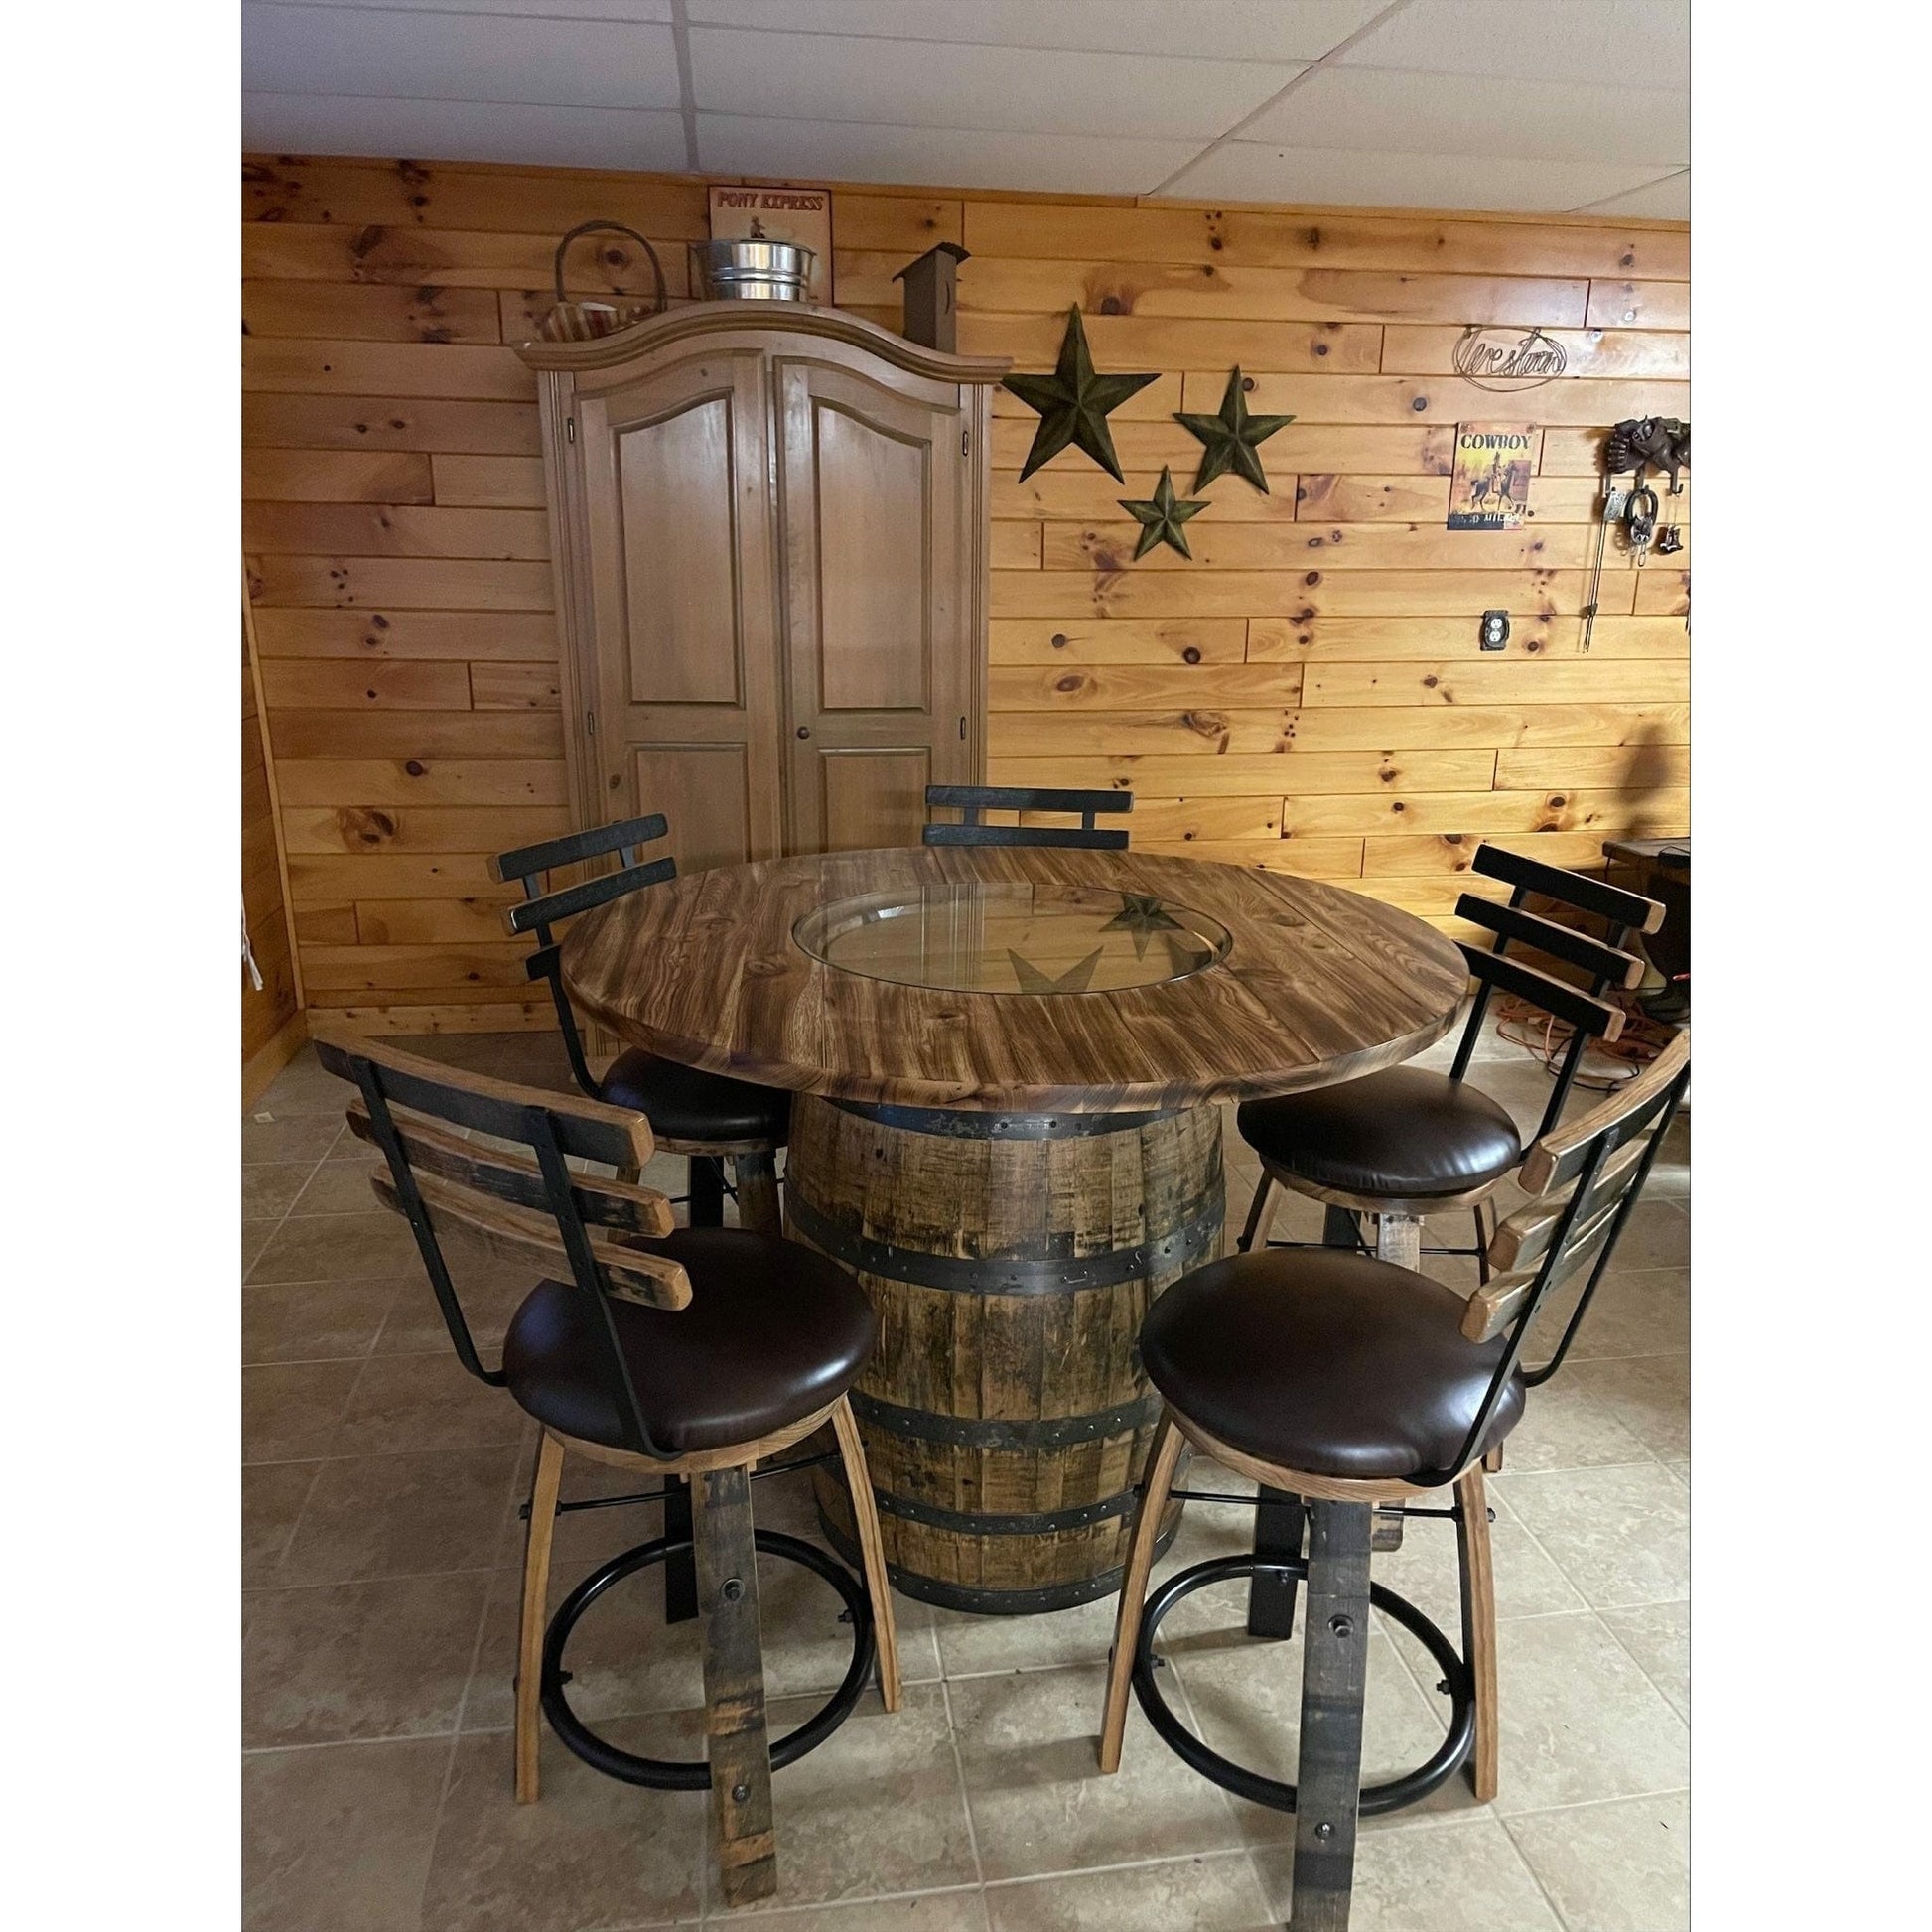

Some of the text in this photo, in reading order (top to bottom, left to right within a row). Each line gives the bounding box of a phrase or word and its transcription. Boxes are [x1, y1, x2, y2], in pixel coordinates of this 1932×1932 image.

[718, 192, 823, 210] PONY EXPRESS
[1460, 434, 1532, 450] COWBOY
